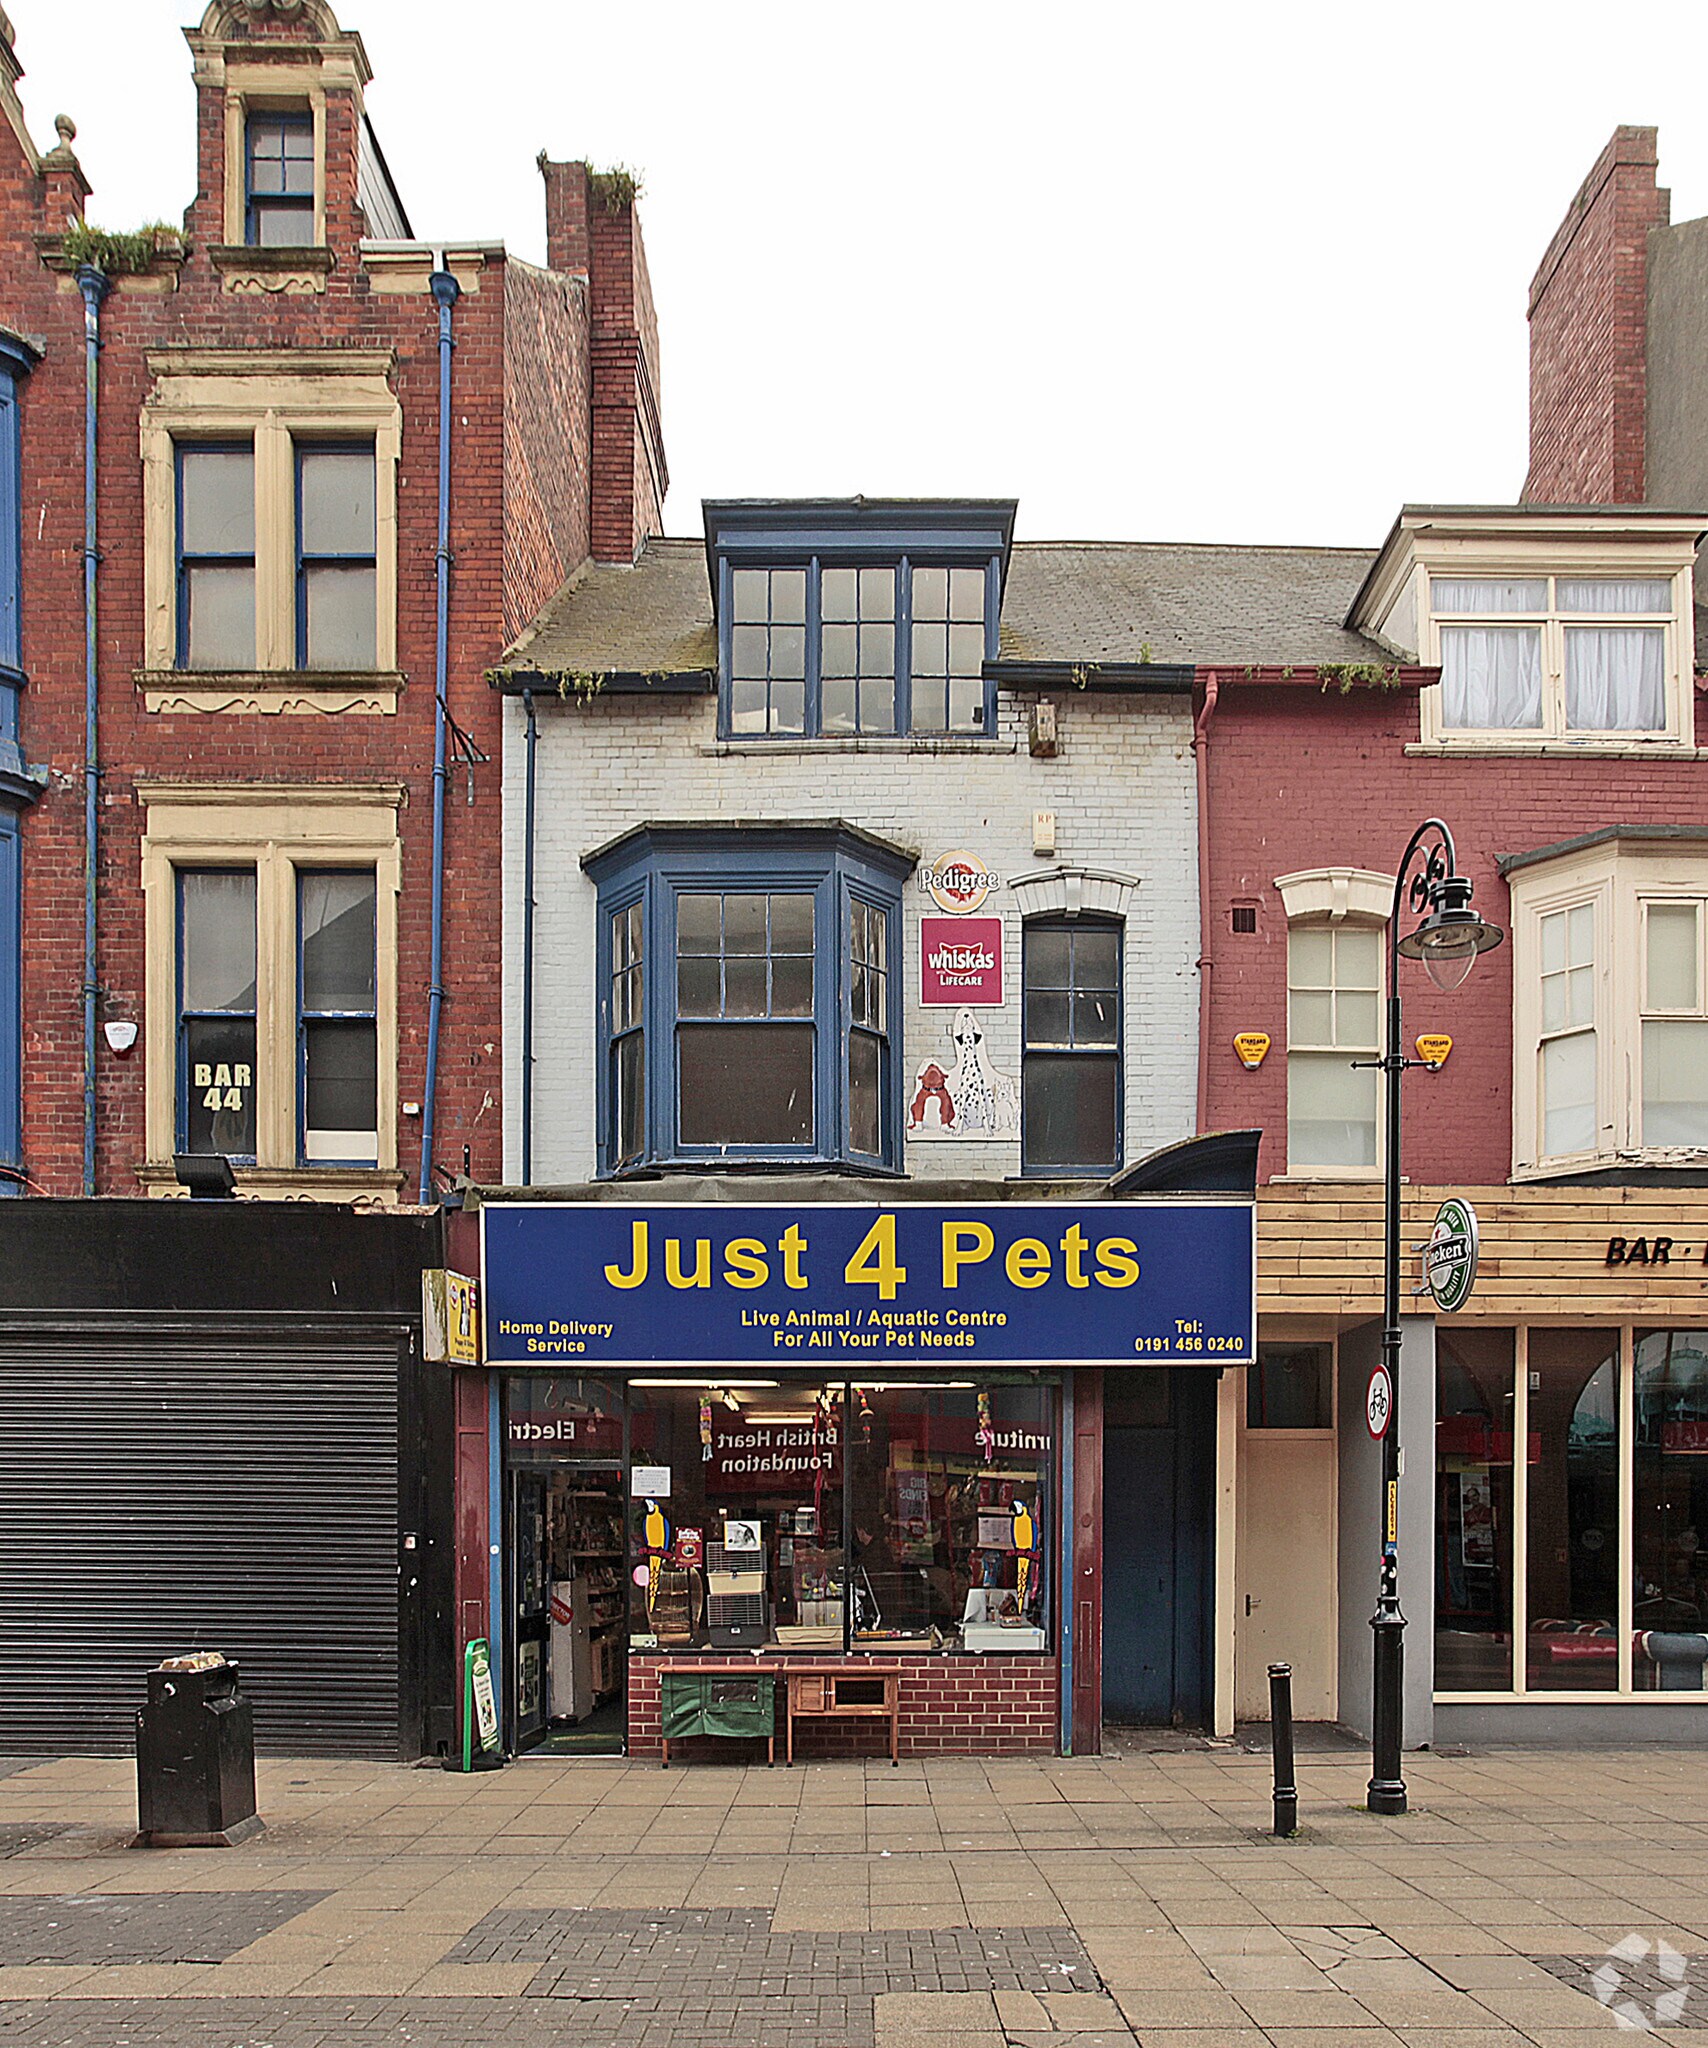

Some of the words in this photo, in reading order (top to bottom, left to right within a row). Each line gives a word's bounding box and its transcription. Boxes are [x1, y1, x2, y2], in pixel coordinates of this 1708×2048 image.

[921, 868, 997, 894] Pedigree
[928, 949, 994, 969] whiskas
[194, 1063, 251, 1087] BAR
[202, 1087, 243, 1112] 44
[604, 1221, 809, 1288] Just
[845, 1215, 907, 1300] 4
[942, 1221, 1140, 1288] Pets
[1606, 1236, 1673, 1264] BAR
[499, 1320, 544, 1335] Home
[550, 1320, 613, 1338] Delivery
[741, 1310, 780, 1326] Live
[785, 1310, 850, 1326] Animal
[856, 1310, 863, 1326] /
[867, 1310, 939, 1329] Aquatic
[945, 1310, 1007, 1326] Centre
[1175, 1319, 1203, 1333] Tel:
[527, 1337, 586, 1353] Service
[773, 1331, 804, 1347] For
[808, 1331, 833, 1347] All
[839, 1331, 880, 1347] Your
[886, 1331, 915, 1347] Pet
[920, 1331, 975, 1347] Needs
[1135, 1337, 1169, 1351] 0191
[1175, 1337, 1203, 1351] 456
[1207, 1337, 1243, 1351] 0240
